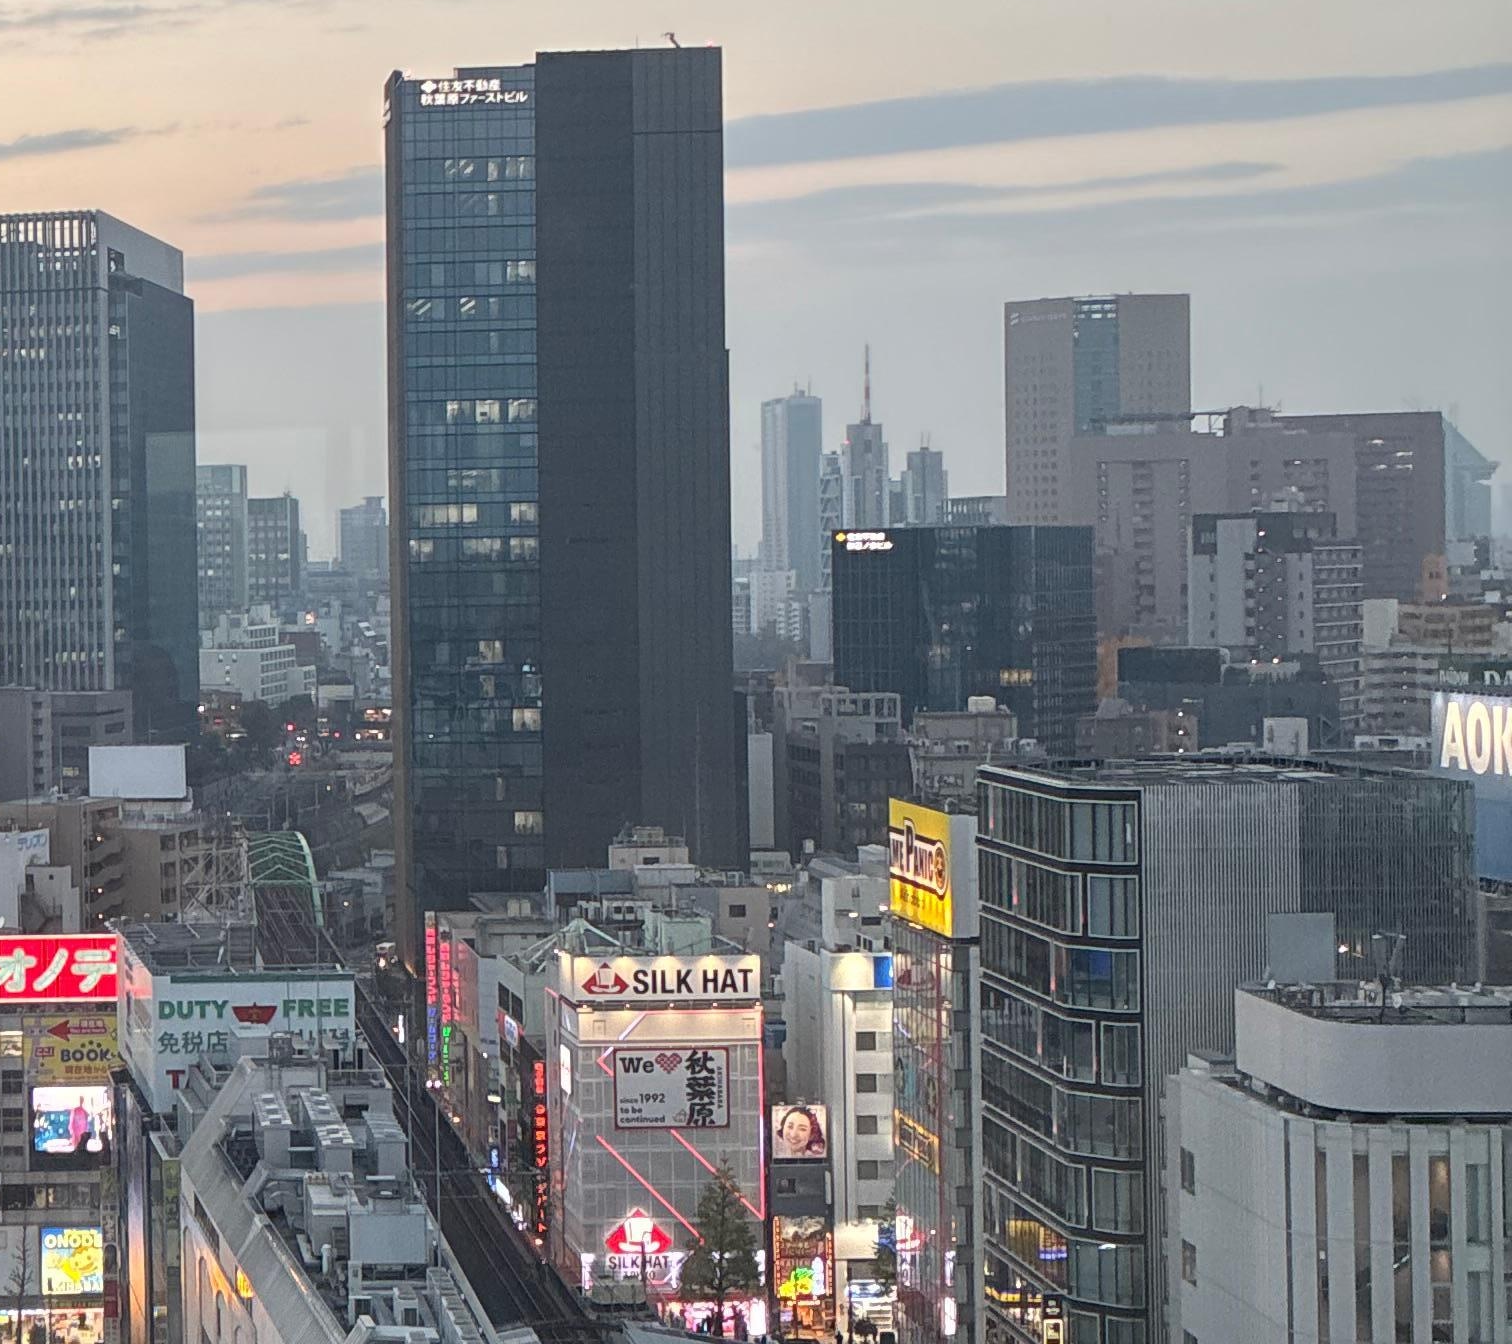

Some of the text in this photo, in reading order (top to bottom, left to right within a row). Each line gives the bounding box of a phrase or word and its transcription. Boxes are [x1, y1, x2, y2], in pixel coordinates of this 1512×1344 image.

[438, 79, 501, 93] 住友不動産
[420, 91, 528, 106] 秋葉原ファーストビル
[633, 968, 754, 995] SILK HAT
[158, 998, 350, 1020] DUTY FREE
[158, 1029, 229, 1055] 免税店
[619, 1056, 654, 1074] We
[685, 1049, 717, 1126] 秋葉原
[639, 1092, 665, 1104] 1992
[619, 1106, 643, 1114] to be
[619, 1115, 666, 1124] continued
[608, 1255, 670, 1270] SILK HAT
